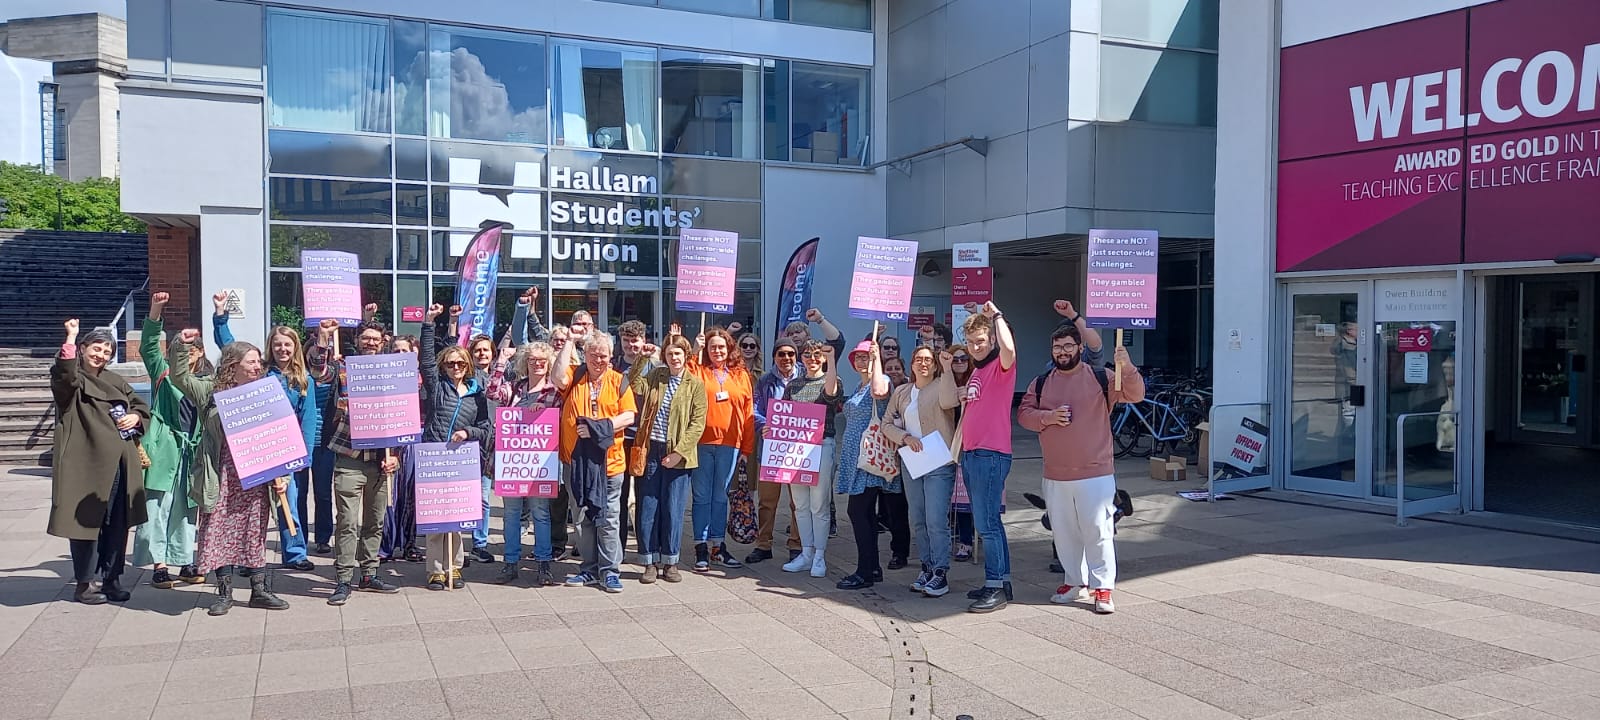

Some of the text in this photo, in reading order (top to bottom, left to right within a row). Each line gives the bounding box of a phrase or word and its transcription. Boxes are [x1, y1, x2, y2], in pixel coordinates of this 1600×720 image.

[1501, 136, 1559, 160] GOLD
[1564, 133, 1583, 153] IN
[551, 166, 656, 193] Hallam
[1343, 176, 1422, 200] TEACHING
[1557, 159, 1600, 180] FRA
[552, 238, 637, 262] Union
[788, 264, 806, 320] lcome
[368, 371, 414, 379] sector-wide
[220, 384, 274, 406] These are NOT
[223, 394, 284, 419] just sector-wide
[374, 400, 408, 409] gambled
[773, 402, 792, 413] ON
[227, 410, 272, 429] challenges.
[502, 410, 522, 421] ON
[772, 415, 818, 429] STRIKE
[381, 422, 414, 431] projects.
[502, 424, 552, 434] STRIKE
[233, 424, 288, 446] They gambled
[771, 428, 815, 441] TODAY
[236, 449, 250, 458] our
[252, 441, 276, 453] future
[502, 438, 549, 448] TODAY
[770, 442, 804, 455] UCU &
[1236, 434, 1262, 452] OFFICIAL
[503, 453, 540, 464] UCU &
[768, 455, 810, 468] PROUD
[1230, 448, 1255, 463] PICKET
[240, 456, 264, 469] vanity
[502, 467, 548, 478] PROUD
[439, 485, 471, 494] gambled
